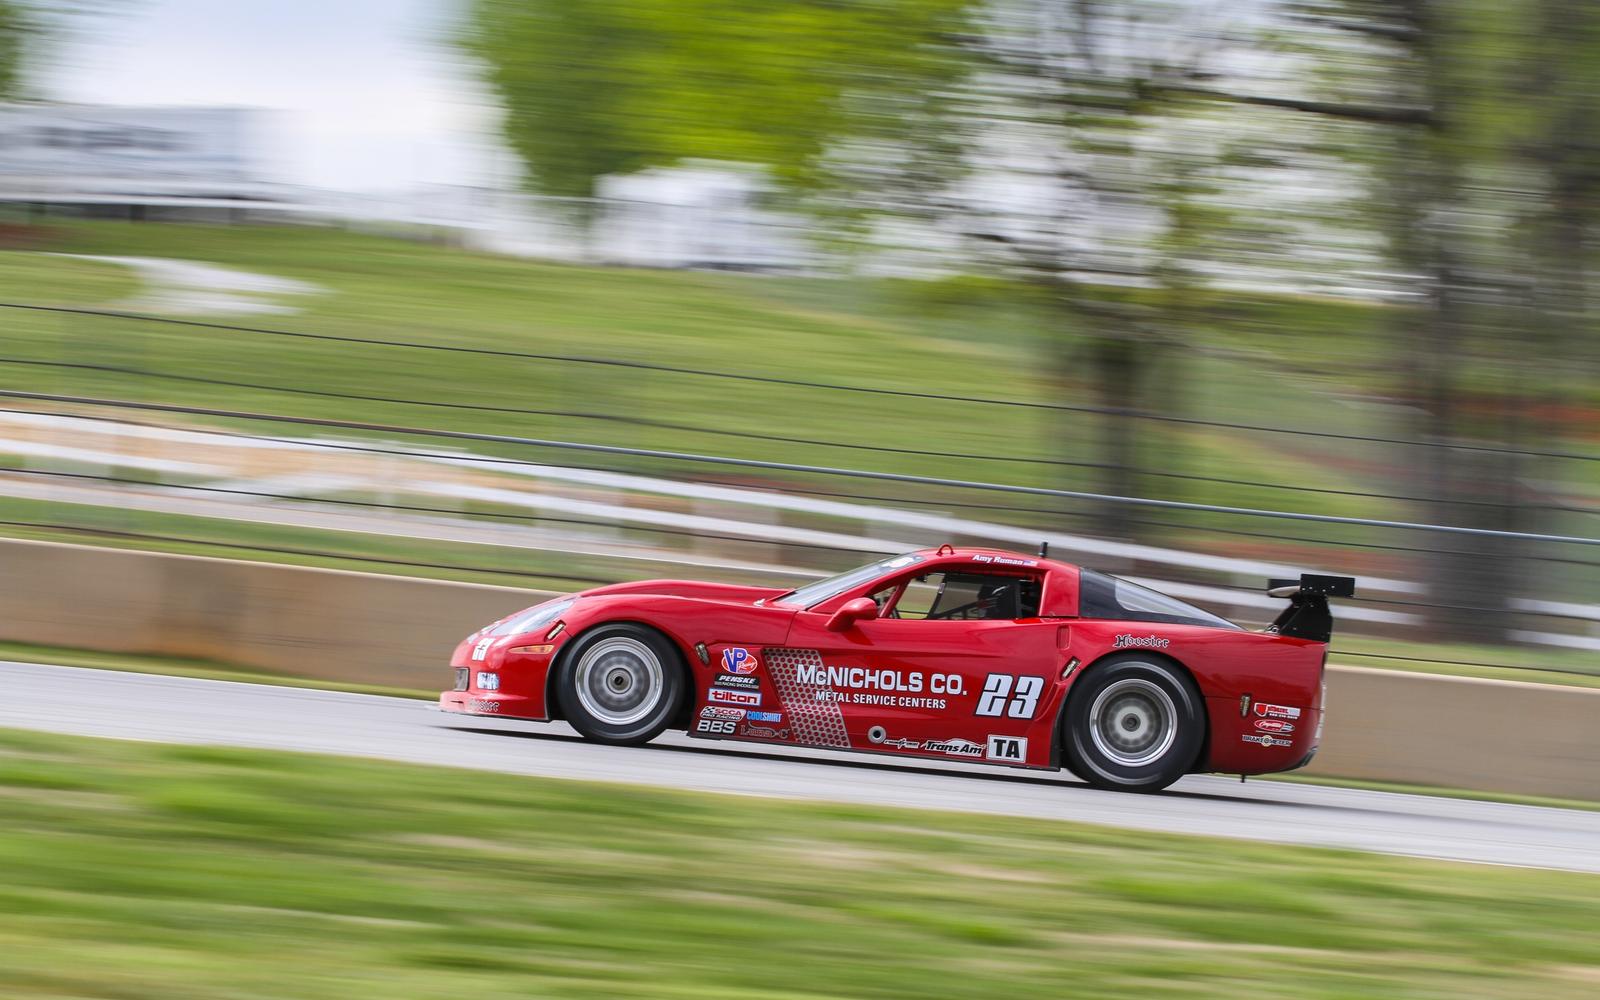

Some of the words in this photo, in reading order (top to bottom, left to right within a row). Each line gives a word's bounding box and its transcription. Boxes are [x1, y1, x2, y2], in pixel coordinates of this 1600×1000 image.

[972, 554, 992, 564] Amy
[1112, 634, 1170, 648] Hoosier
[723, 647, 748, 673] VP
[719, 675, 756, 683] PENSKE
[796, 664, 923, 693] McNICHOLS
[930, 673, 967, 695] CO.
[712, 691, 757, 704] tilton
[815, 691, 850, 704] METAL
[853, 693, 896, 706] SERVICE
[898, 696, 946, 709] CENTERS
[975, 674, 1045, 720] 23
[714, 708, 742, 716] SCCA
[697, 720, 736, 734] BBS
[925, 740, 959, 752] Trans
[959, 745, 982, 755] Am
[993, 738, 1020, 758] TA
